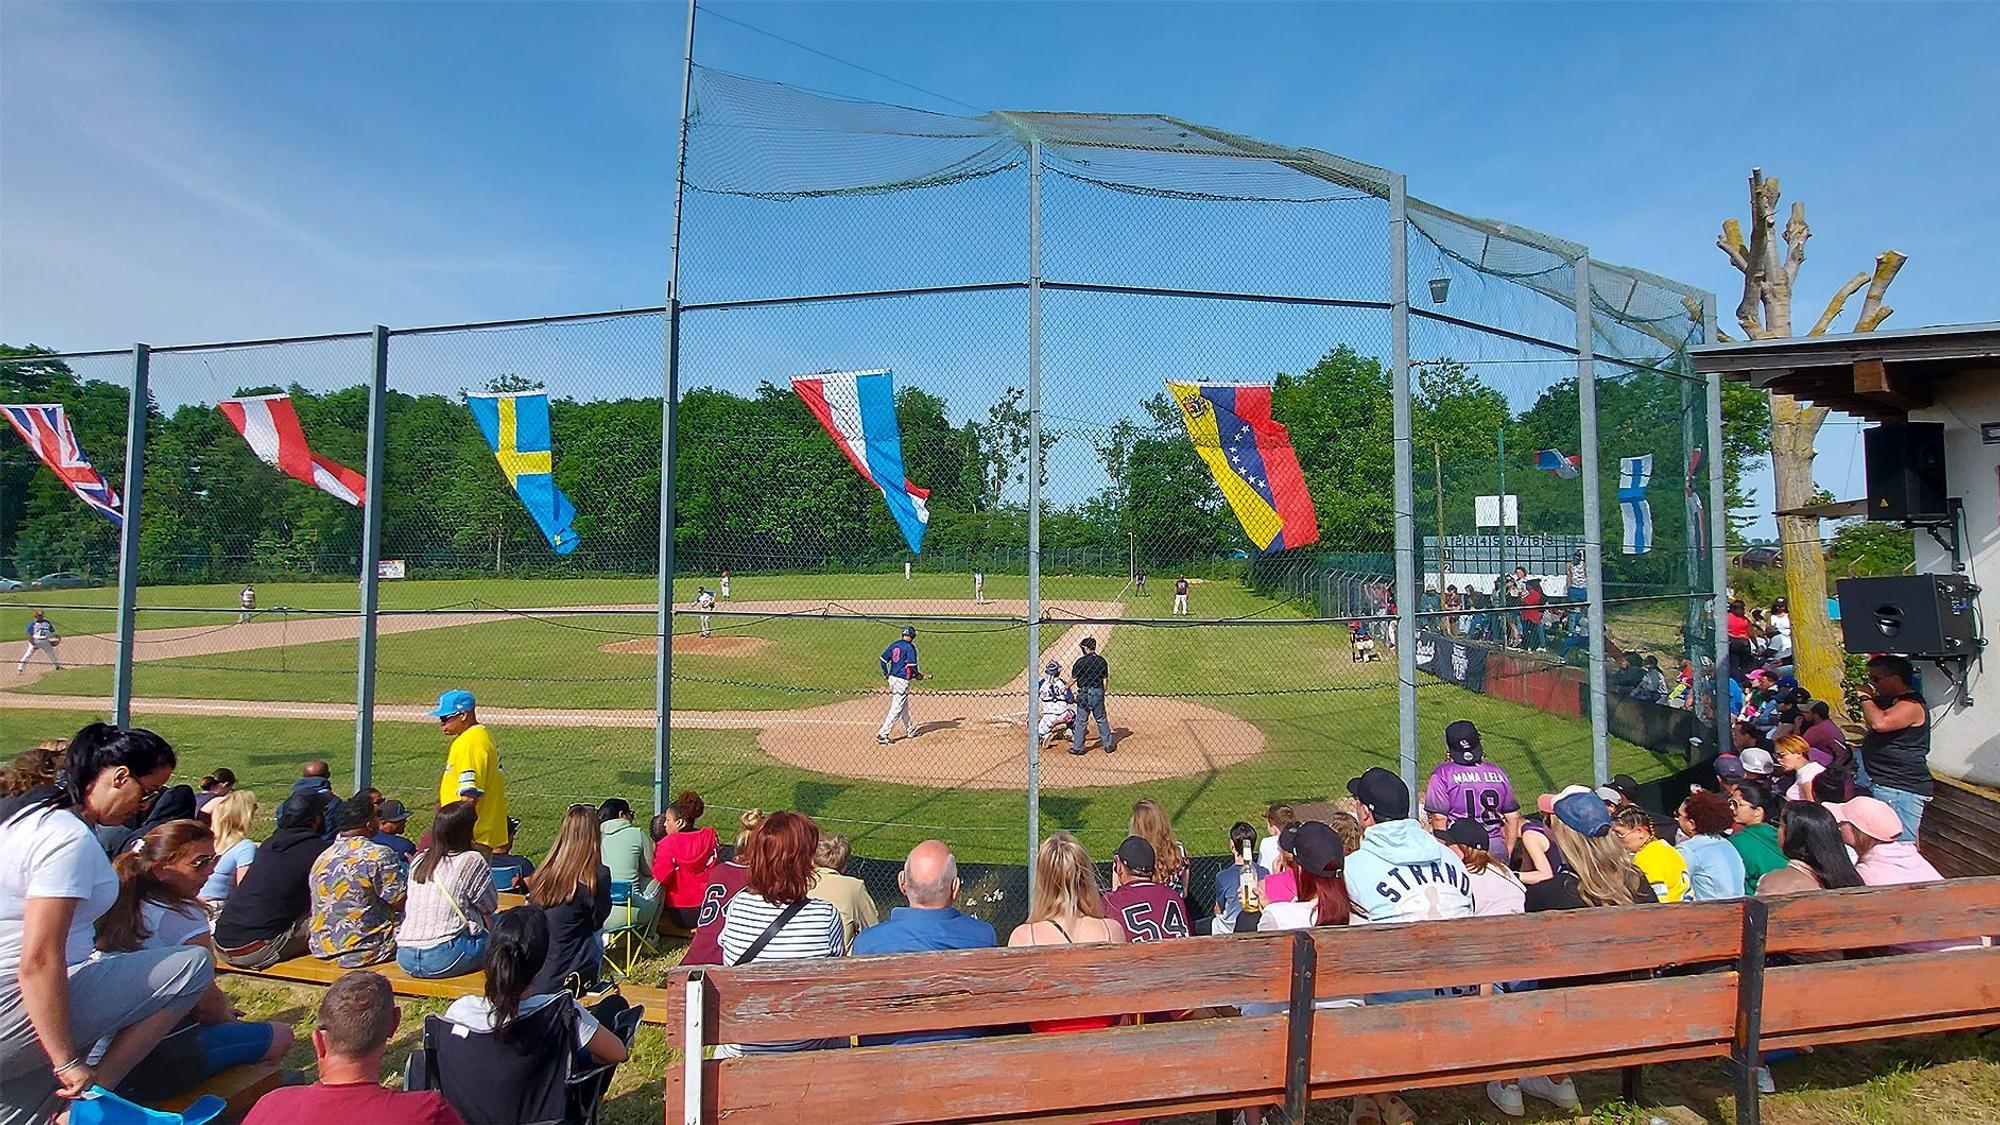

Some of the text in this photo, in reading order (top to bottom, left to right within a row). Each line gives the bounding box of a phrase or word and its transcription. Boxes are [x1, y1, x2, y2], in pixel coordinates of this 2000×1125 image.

[1467, 536, 1476, 546] 3
[1480, 536, 1488, 546] 4
[1506, 536, 1513, 546] 6
[1519, 536, 1527, 546] 7
[1444, 563, 1451, 573] 2
[1464, 787, 1501, 827] 18
[1375, 860, 1471, 904] STRAND
[1121, 900, 1190, 943] 54
